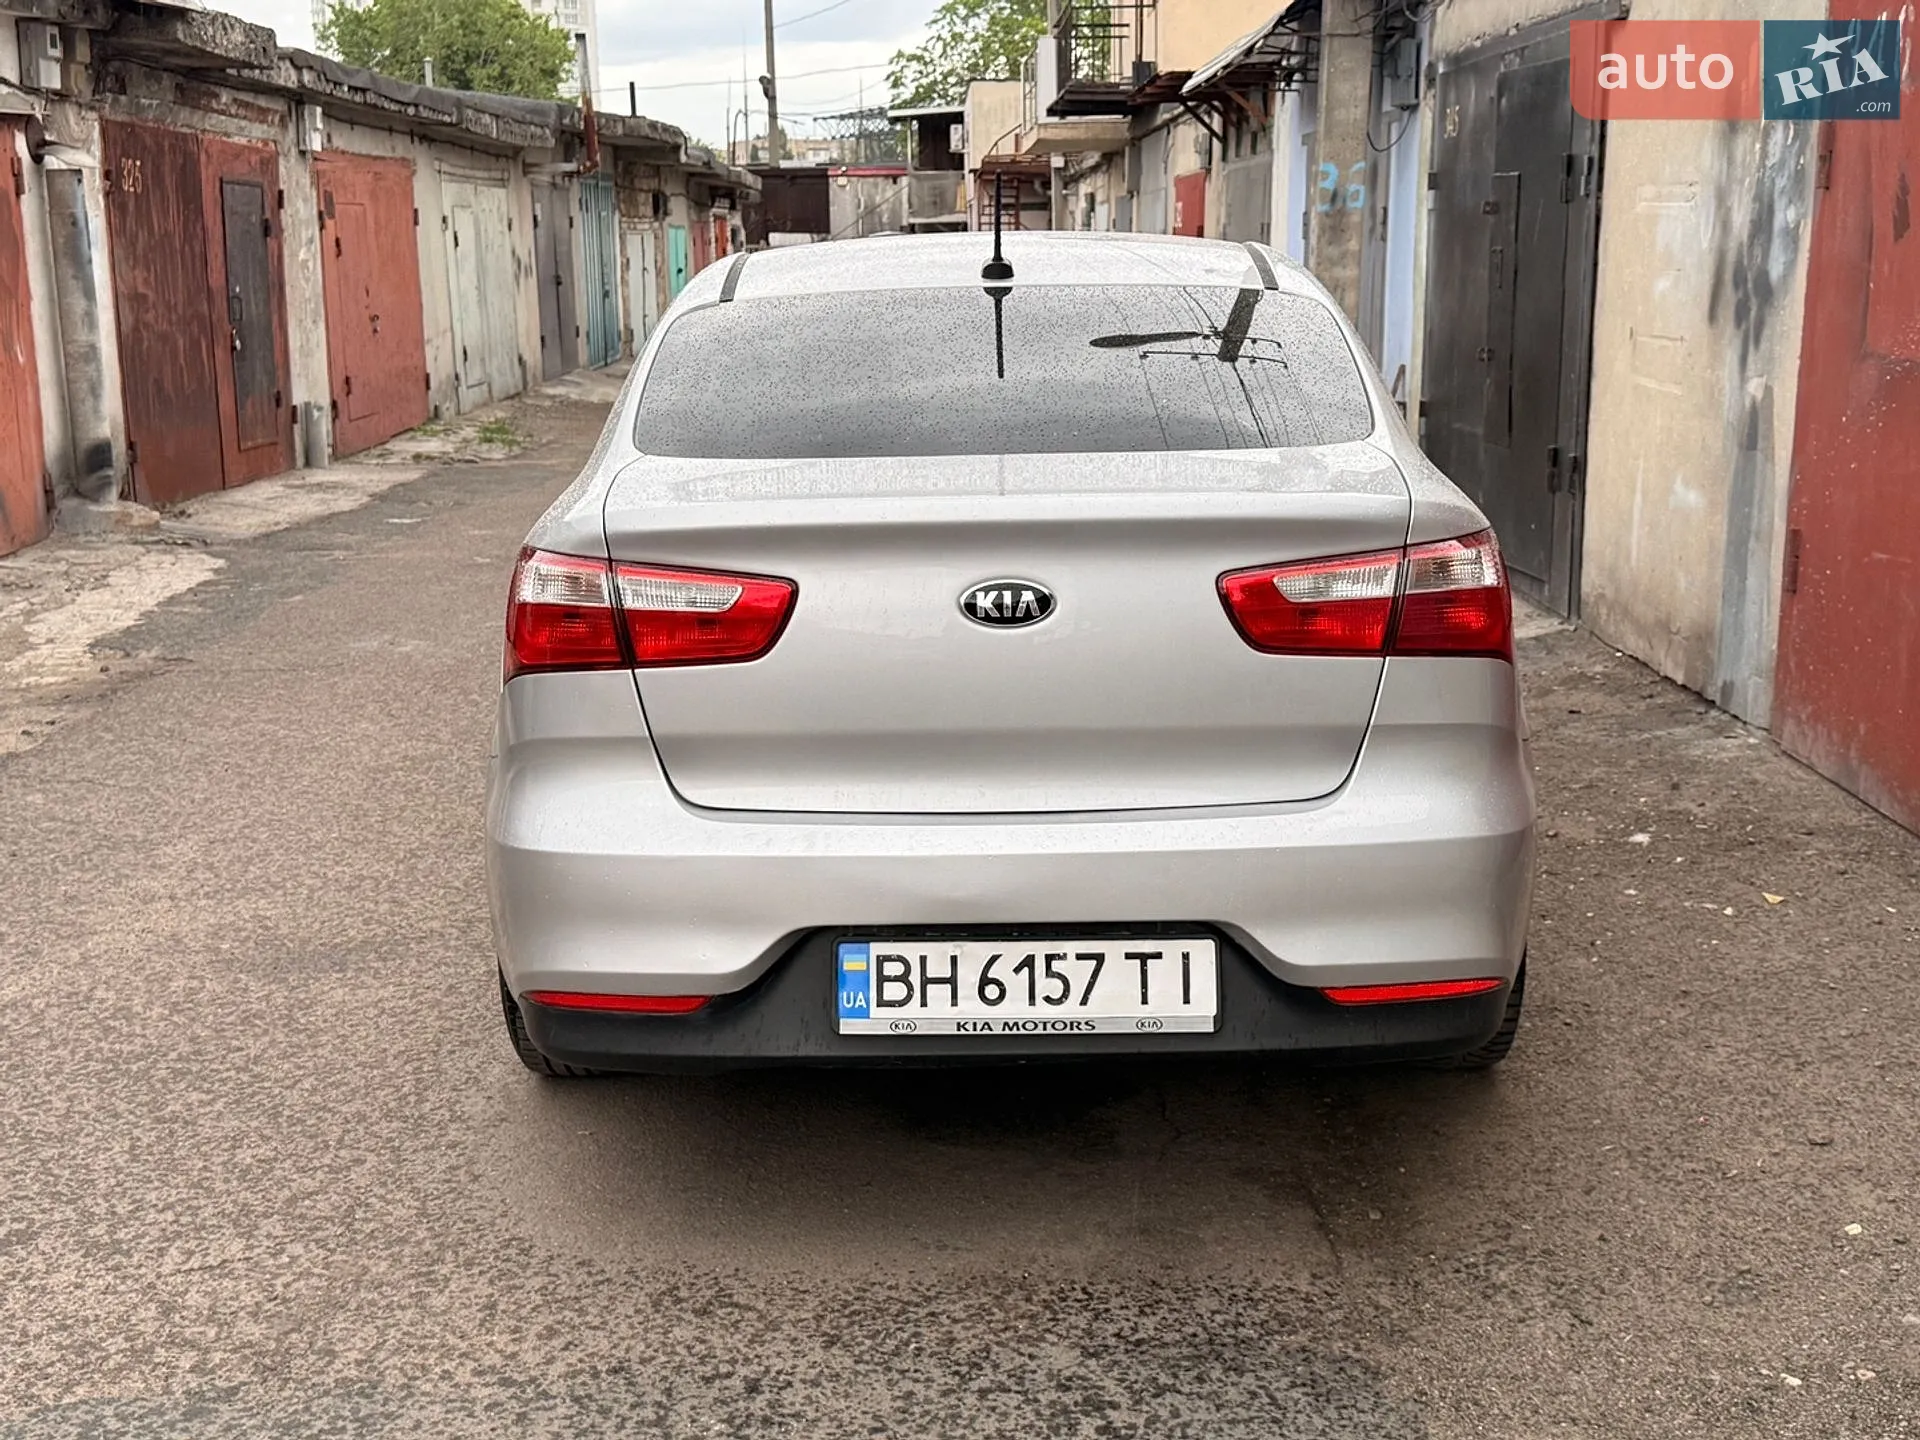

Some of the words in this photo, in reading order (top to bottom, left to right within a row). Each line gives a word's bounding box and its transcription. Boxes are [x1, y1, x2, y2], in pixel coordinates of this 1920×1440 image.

[973, 588, 1043, 619] KIA
[842, 991, 867, 1008] UA
[876, 954, 958, 1008] BH
[978, 952, 1105, 1007] 6157
[1124, 951, 1191, 1006] TI
[892, 1021, 914, 1032] KIA
[956, 1021, 994, 1032] KIA
[1001, 1019, 1096, 1032] MOTORS
[1138, 1020, 1161, 1031] KIA
